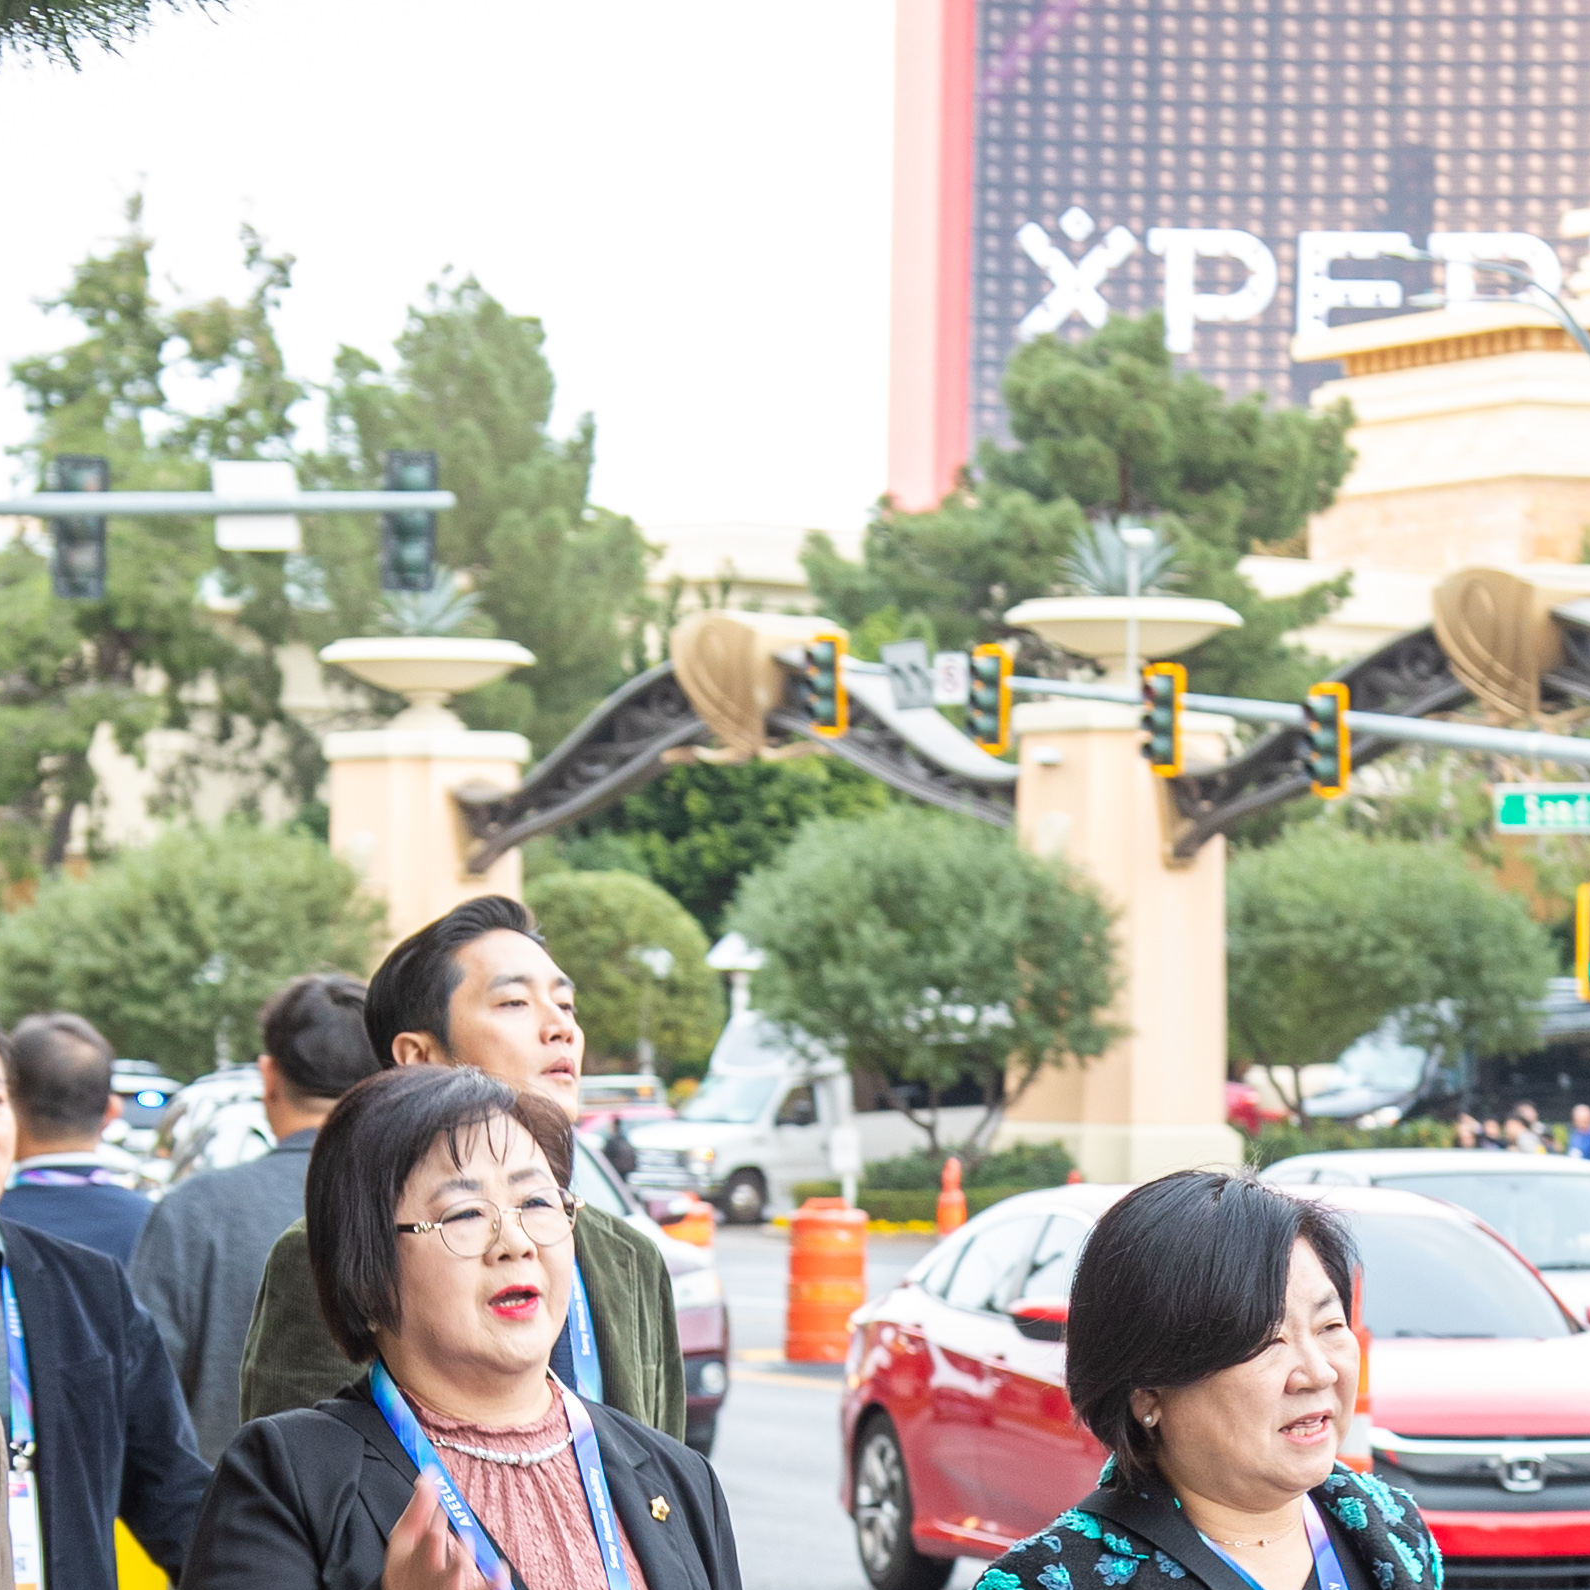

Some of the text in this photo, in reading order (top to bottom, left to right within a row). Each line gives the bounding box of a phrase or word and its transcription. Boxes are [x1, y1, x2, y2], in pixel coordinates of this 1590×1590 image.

[433, 1476, 473, 1527] AFEELA
[589, 1466, 620, 1570] Sony Honda Mobility
